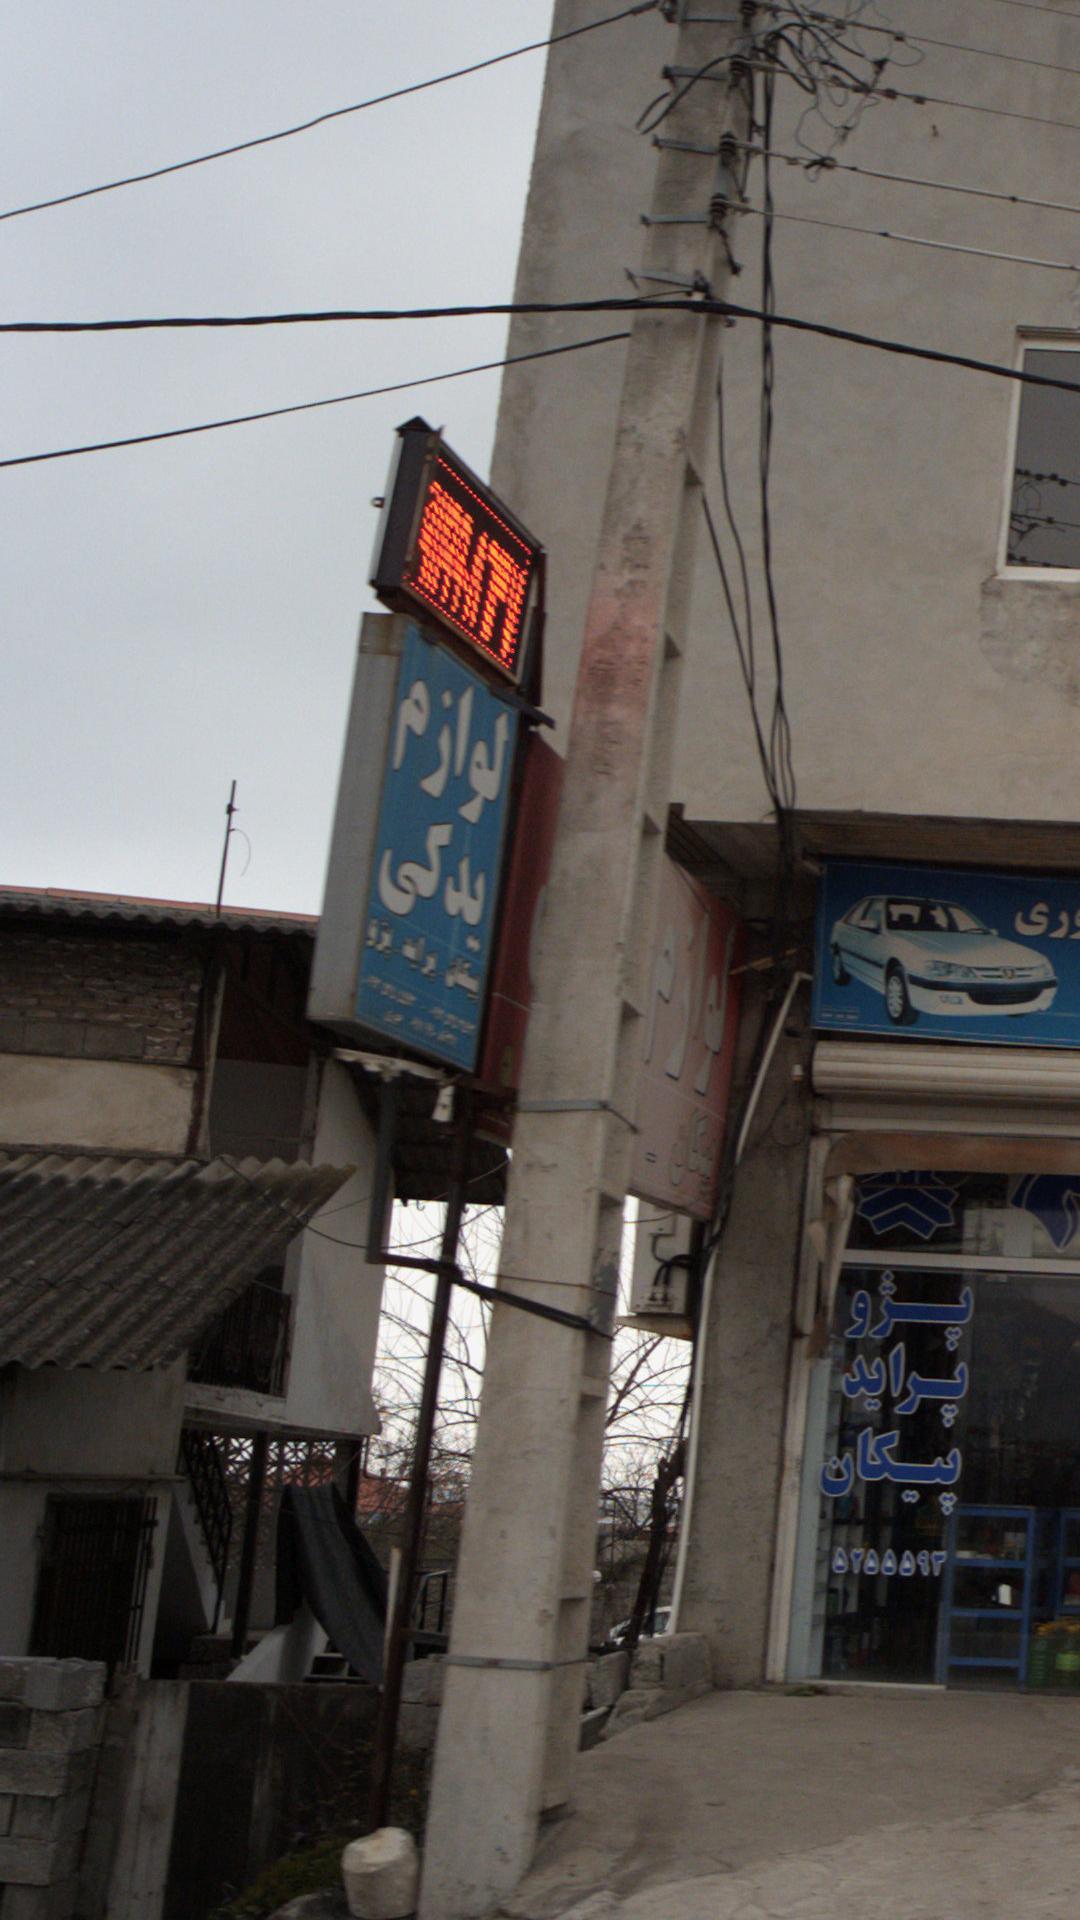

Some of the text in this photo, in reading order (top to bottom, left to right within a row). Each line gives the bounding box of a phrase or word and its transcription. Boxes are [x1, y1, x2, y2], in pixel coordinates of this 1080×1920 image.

[391, 678, 509, 824] لوازم
[378, 822, 486, 953] یدکی
[844, 1269, 975, 1351] پژو
[842, 1341, 969, 1427] پراید
[819, 1426, 962, 1516] پیکان
